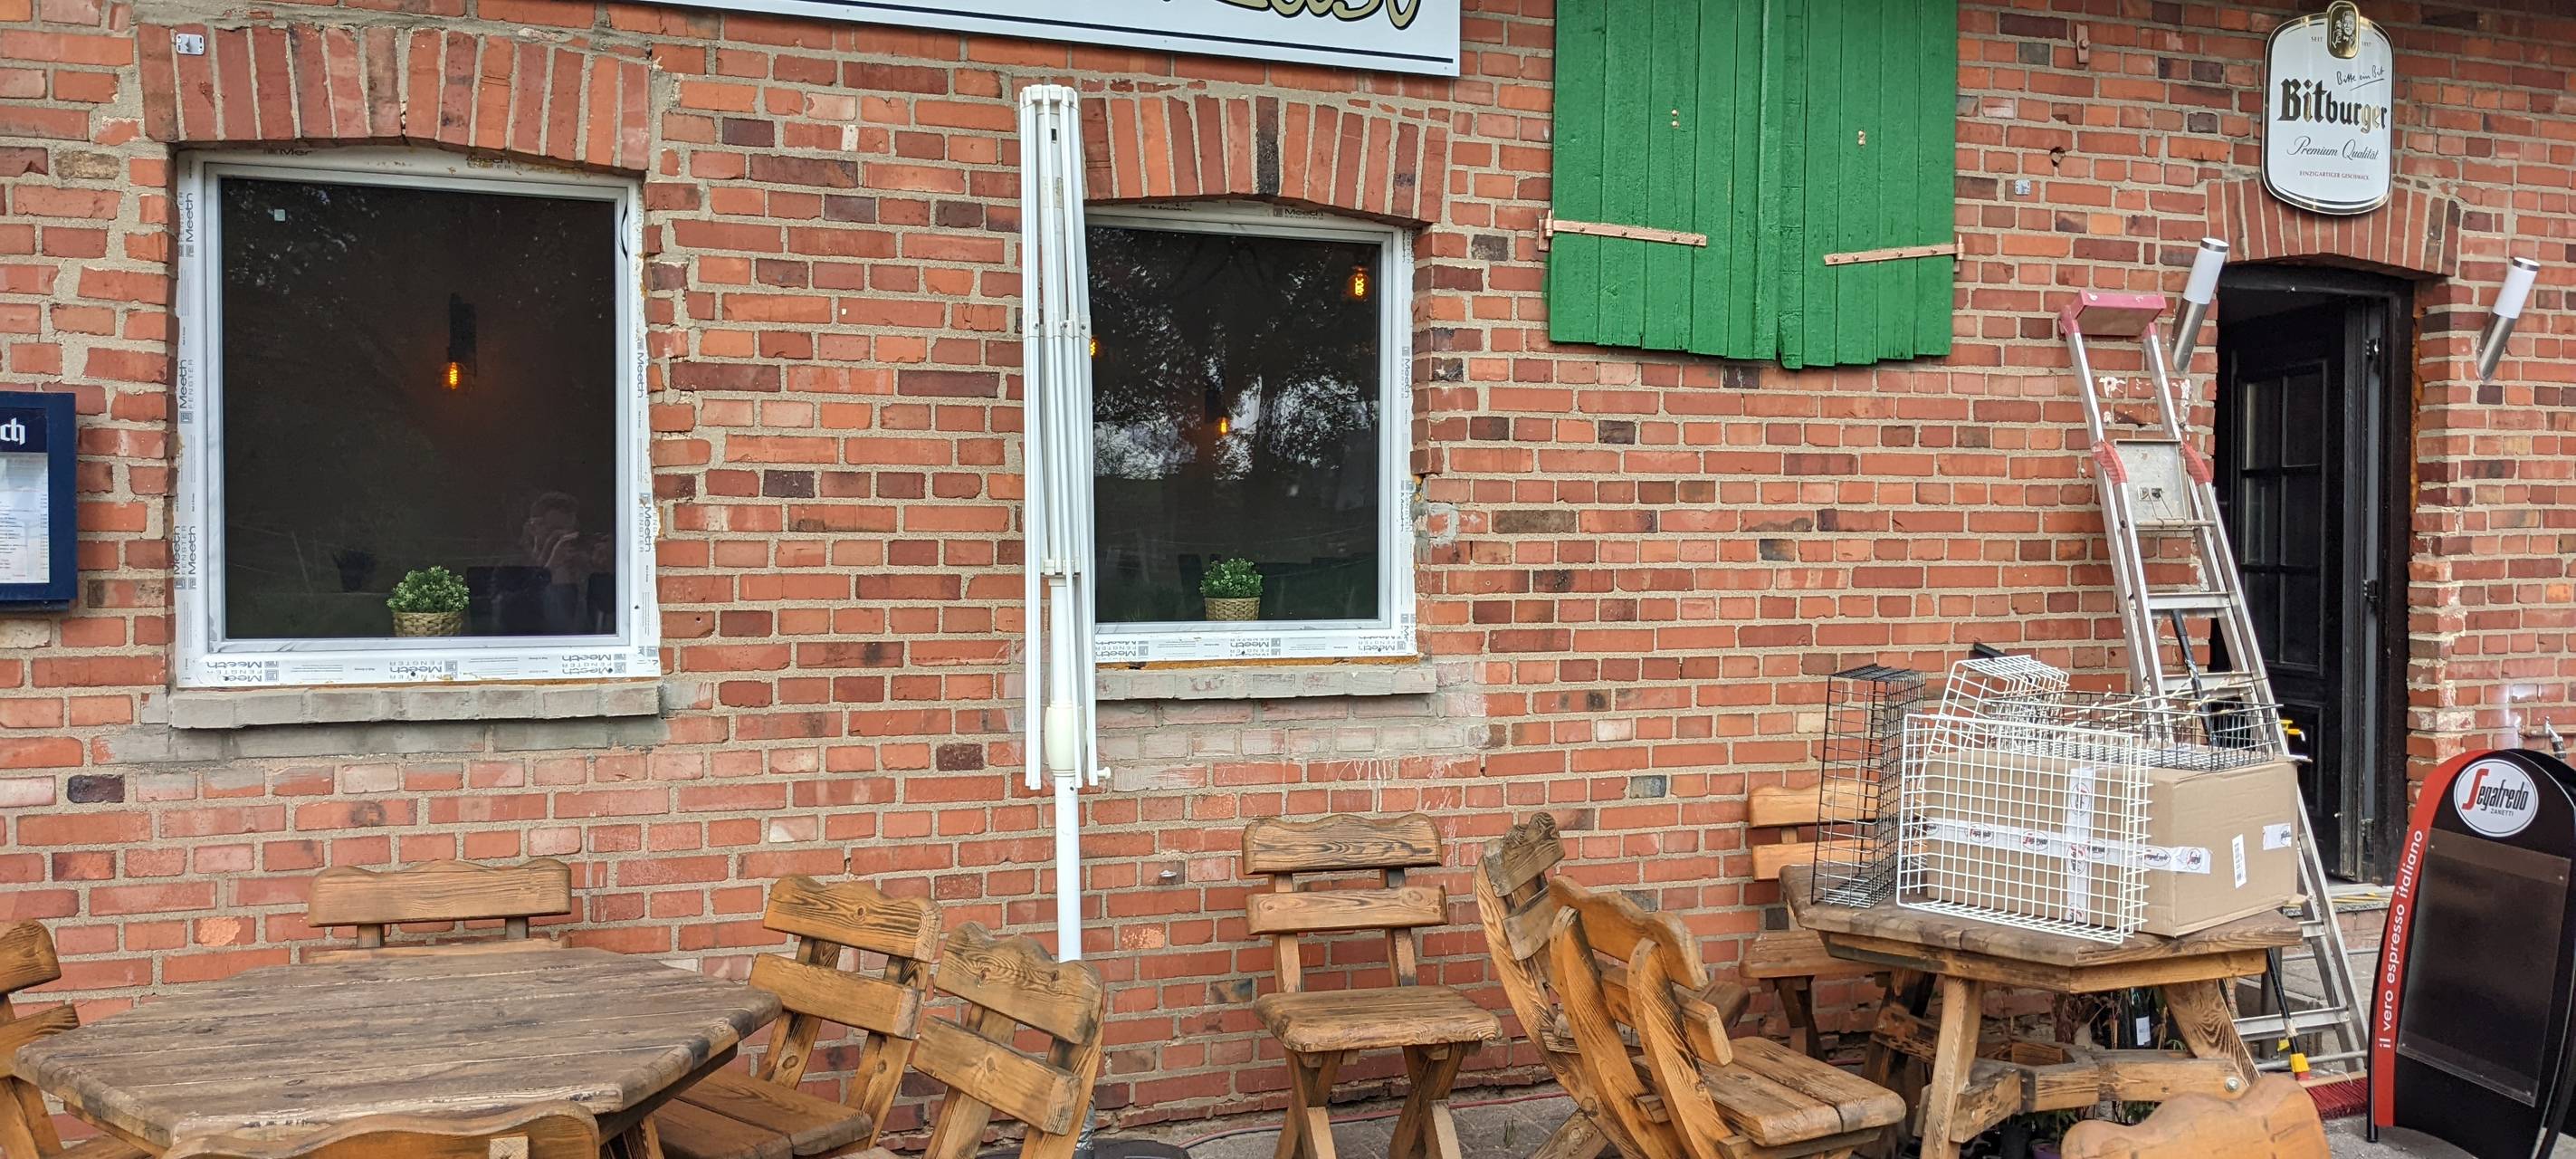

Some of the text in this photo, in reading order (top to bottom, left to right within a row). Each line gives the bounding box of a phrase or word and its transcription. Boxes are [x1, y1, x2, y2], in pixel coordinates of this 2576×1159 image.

[2336, 71, 2357, 85] Bitte
[2372, 64, 2385, 79] Bit
[2276, 78, 2388, 134] Bitburger
[2286, 136, 2380, 161] Premium Qualität
[186, 192, 195, 243] Meeth
[179, 359, 187, 409] Meeth
[636, 352, 644, 398] Meeth
[188, 525, 196, 575] Meeth
[206, 660, 262, 669] Meeth
[562, 654, 612, 662] Meeth
[2461, 768, 2529, 811] Segafredo
[2490, 808, 2514, 817] ZANETTI
[2379, 829, 2423, 1049] il vero espresso italiano
